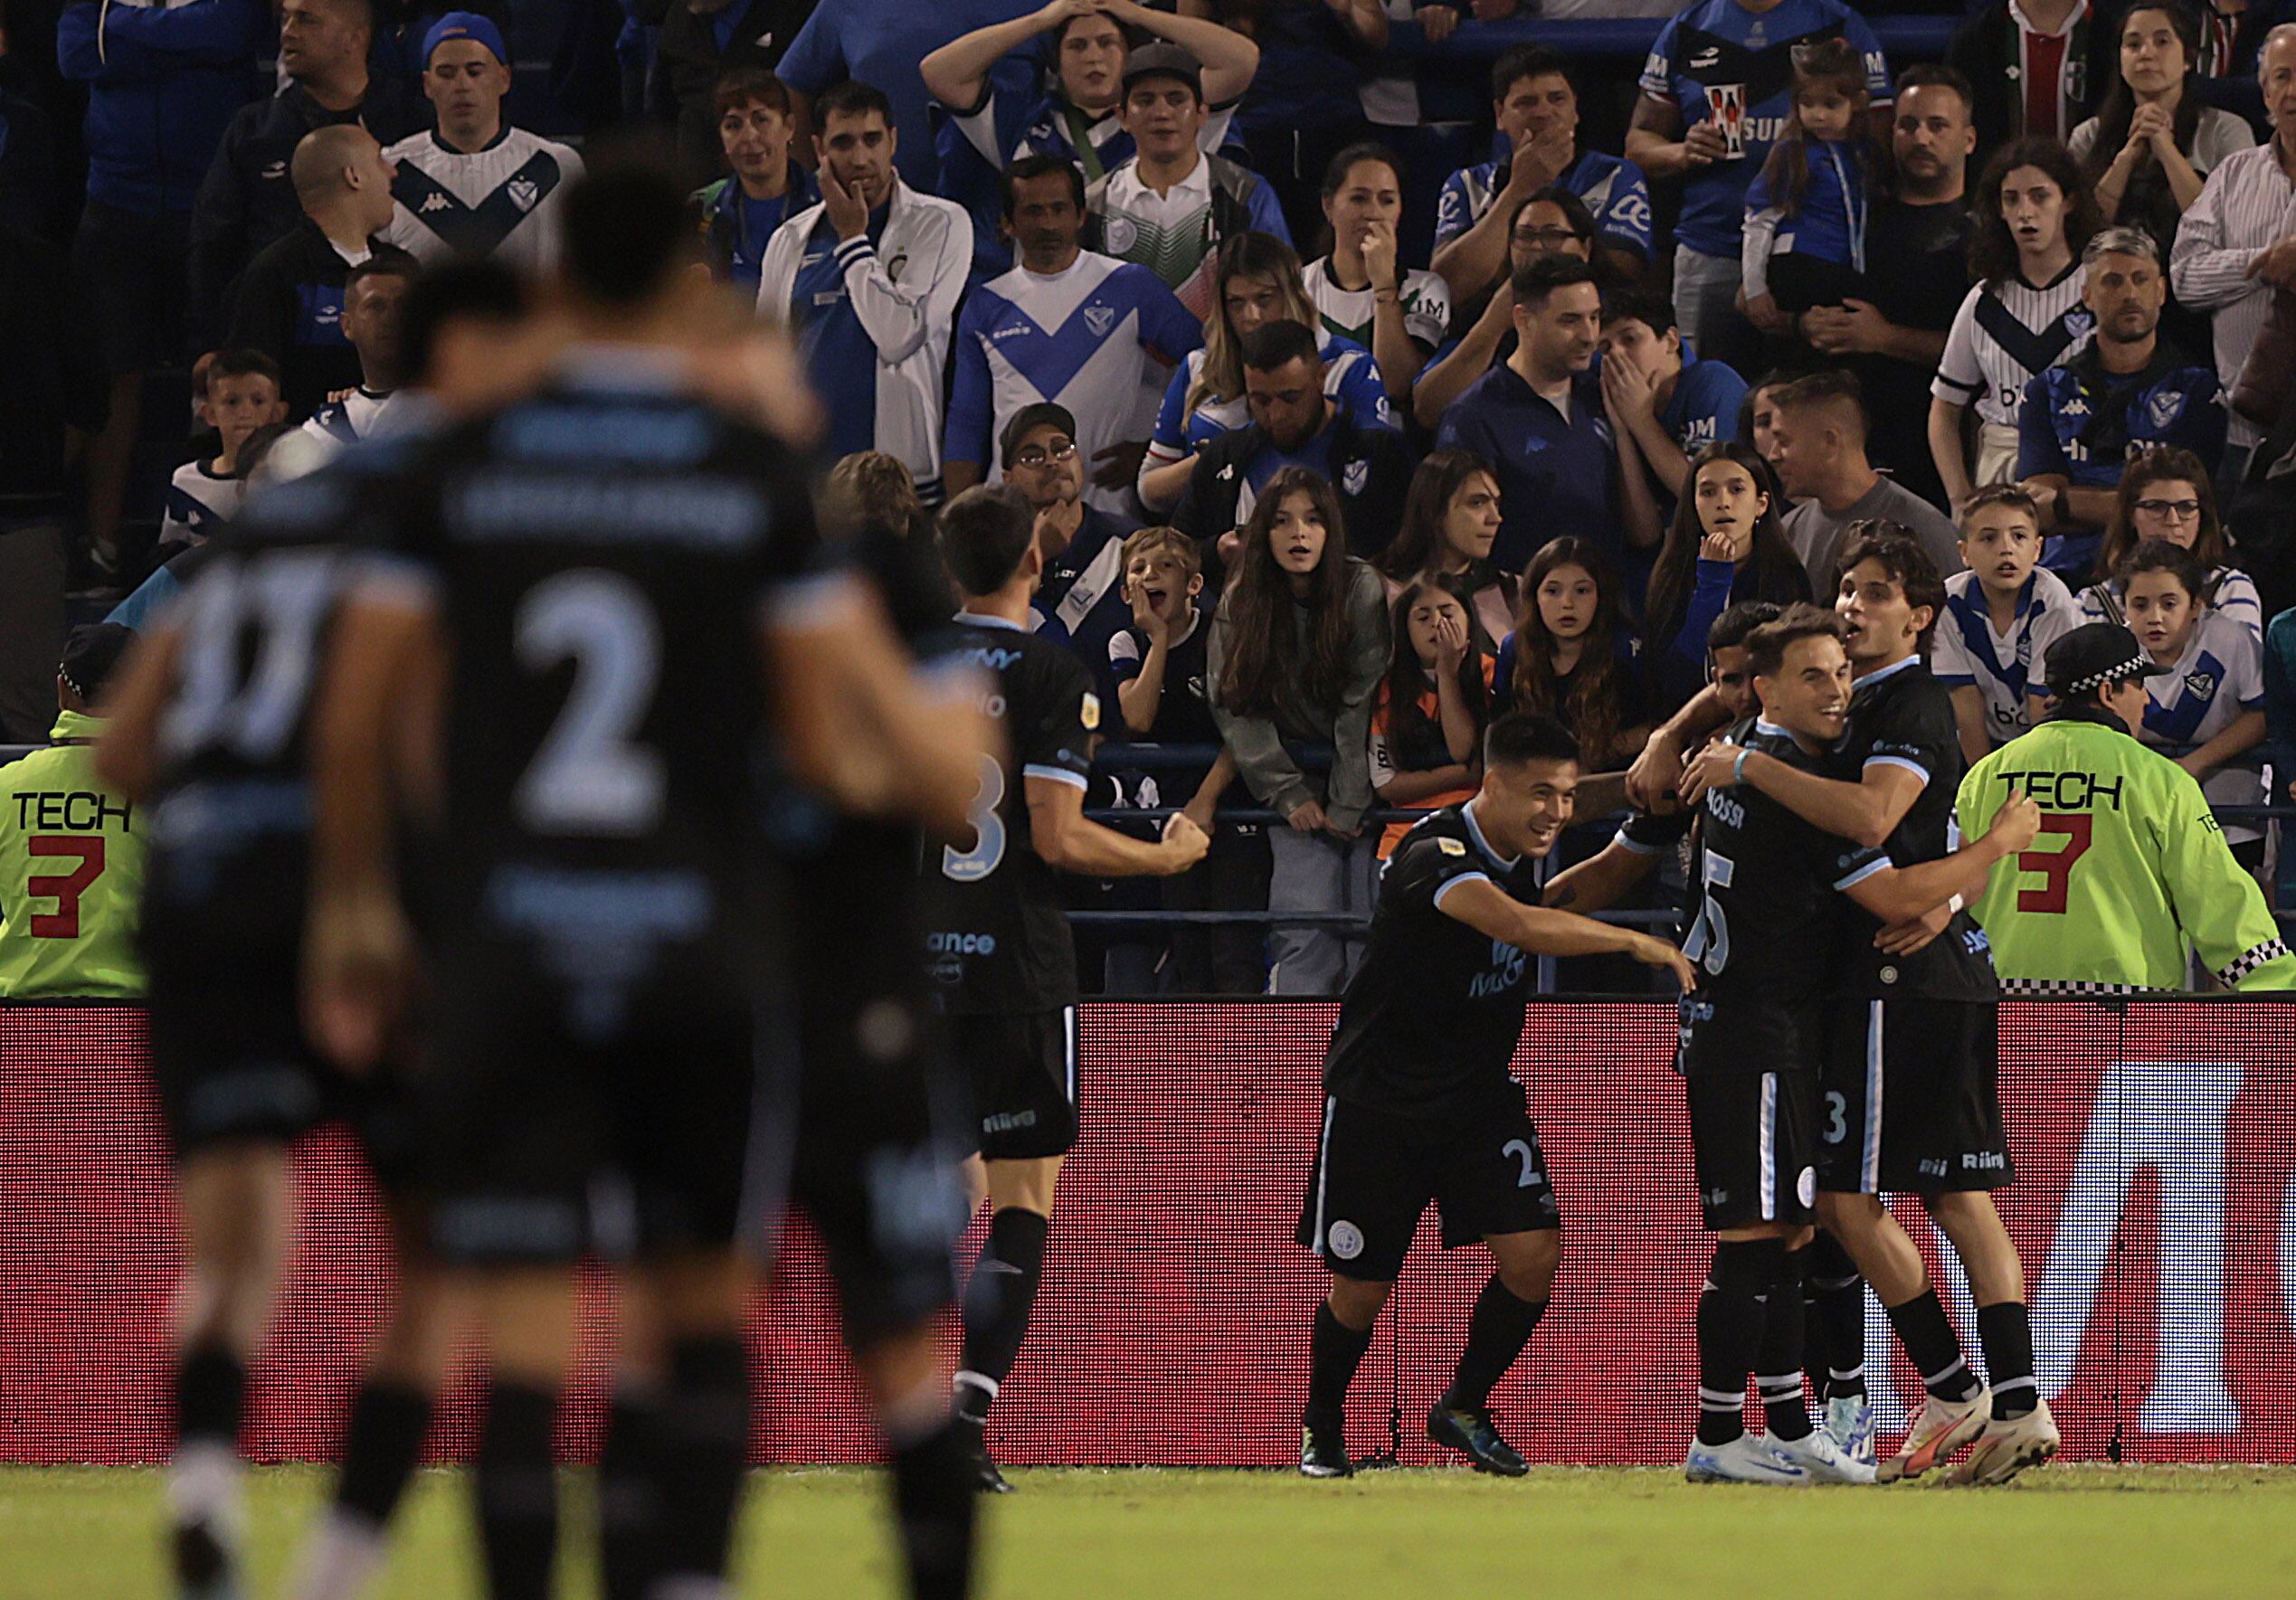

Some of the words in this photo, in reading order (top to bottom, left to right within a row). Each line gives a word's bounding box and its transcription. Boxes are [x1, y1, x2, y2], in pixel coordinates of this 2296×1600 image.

[514, 568, 666, 834] 2
[12, 791, 132, 833] TECH
[1706, 786, 1745, 829] NOSSI
[1997, 772, 2123, 810] TECH
[2196, 813, 2221, 835] TE
[926, 932, 996, 956] ance
[1502, 1137, 1548, 1188] 2
